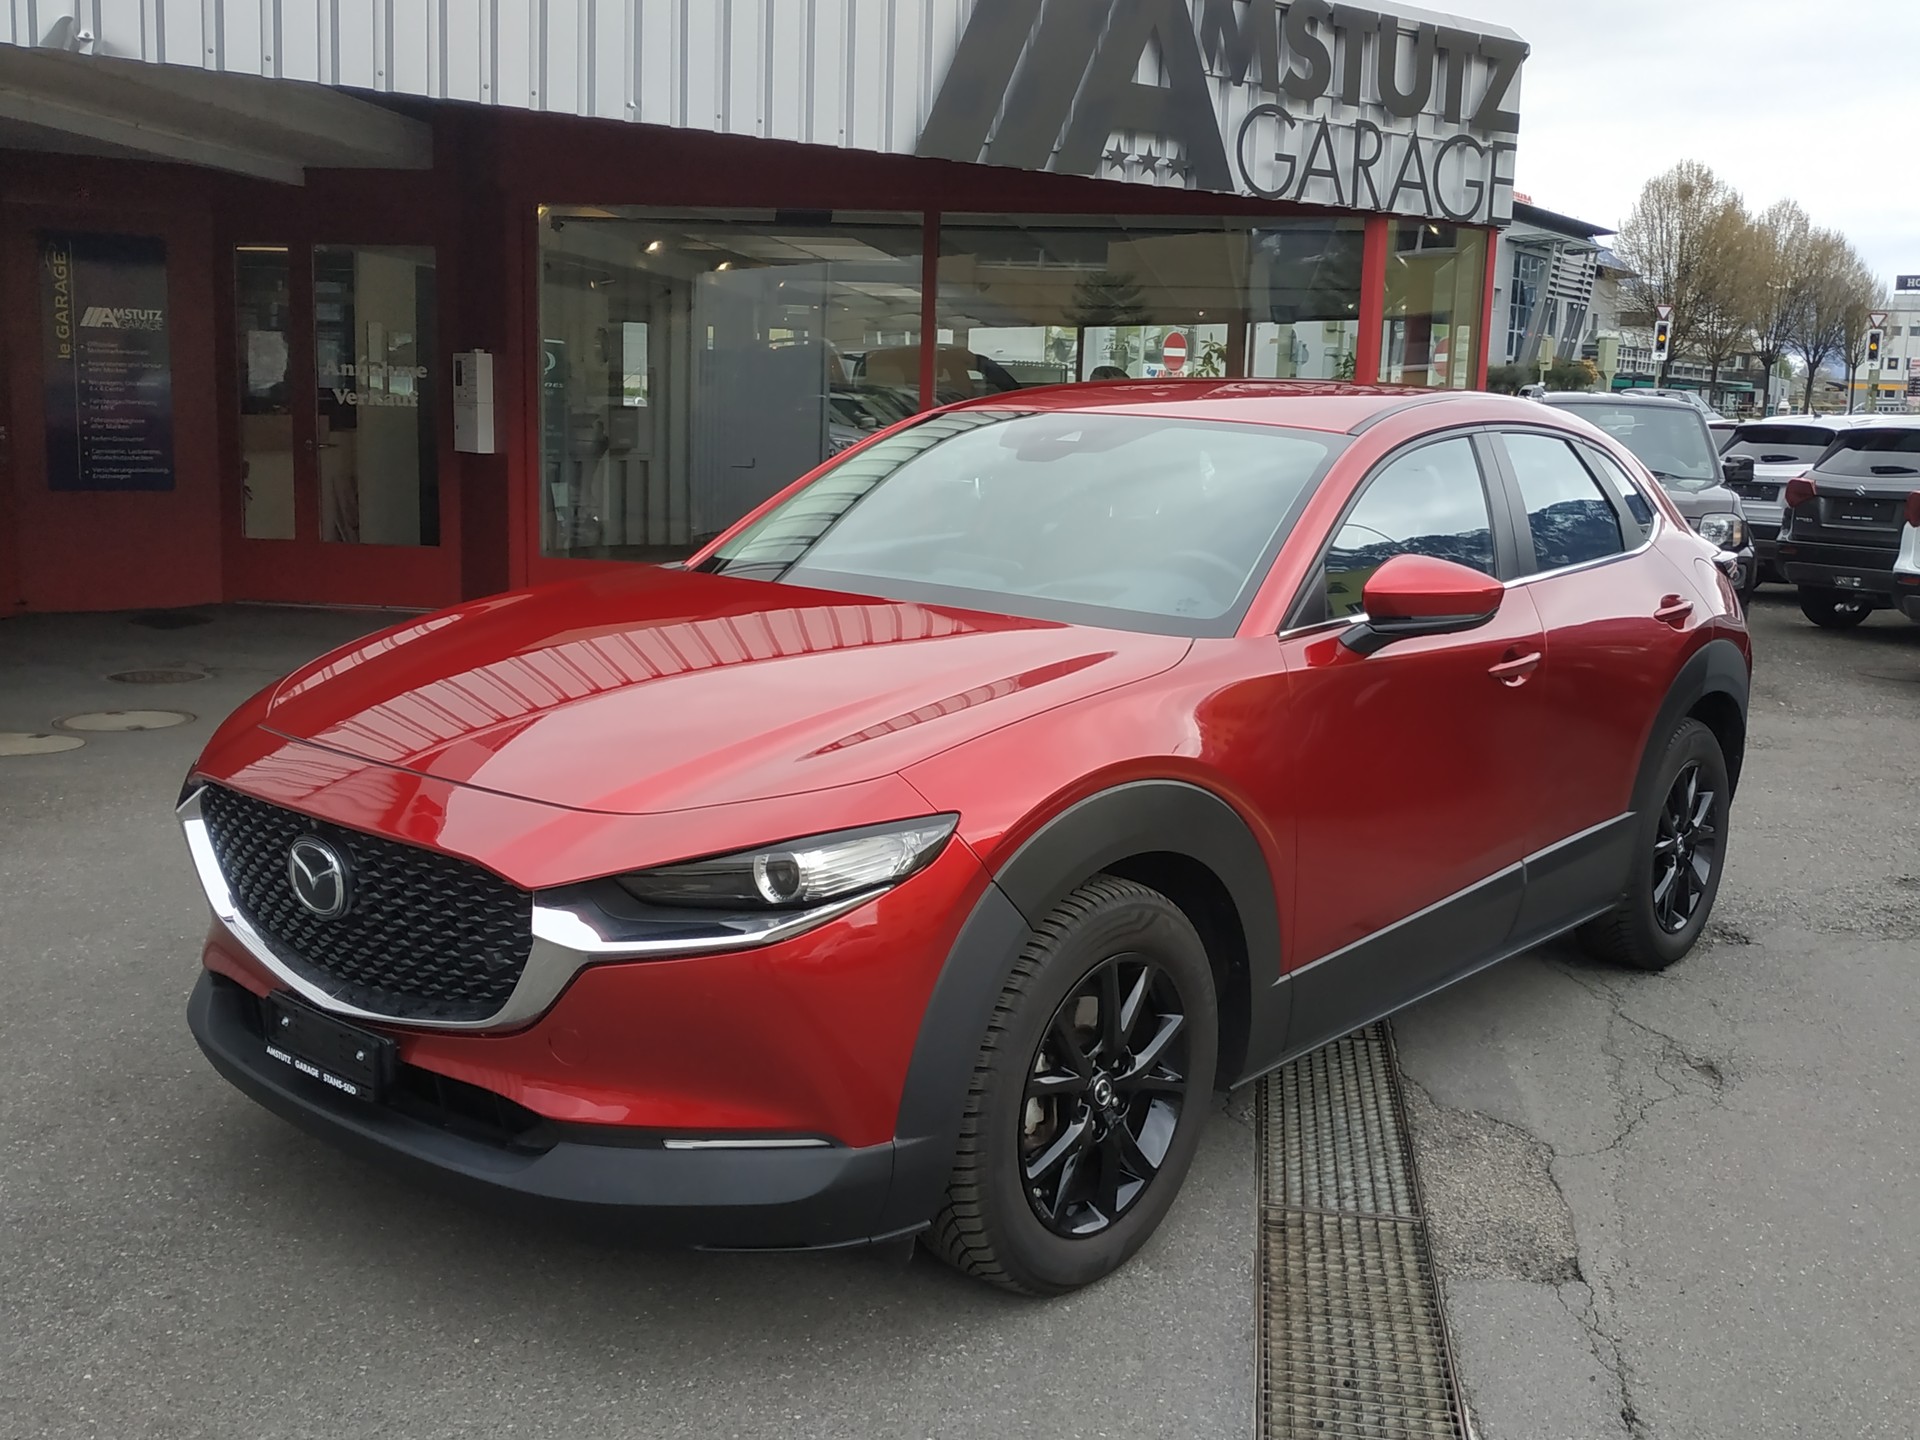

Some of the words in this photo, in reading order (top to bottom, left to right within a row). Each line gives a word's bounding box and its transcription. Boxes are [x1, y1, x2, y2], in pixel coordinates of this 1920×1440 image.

[1236, 103, 1518, 226] GARAGE
[54, 251, 71, 338] GARAGE
[93, 307, 163, 329] AMSTUTZ
[332, 388, 419, 407] Verkauf
[266, 1045, 292, 1065] AMSTUTZ
[294, 1059, 320, 1078] GARAGE
